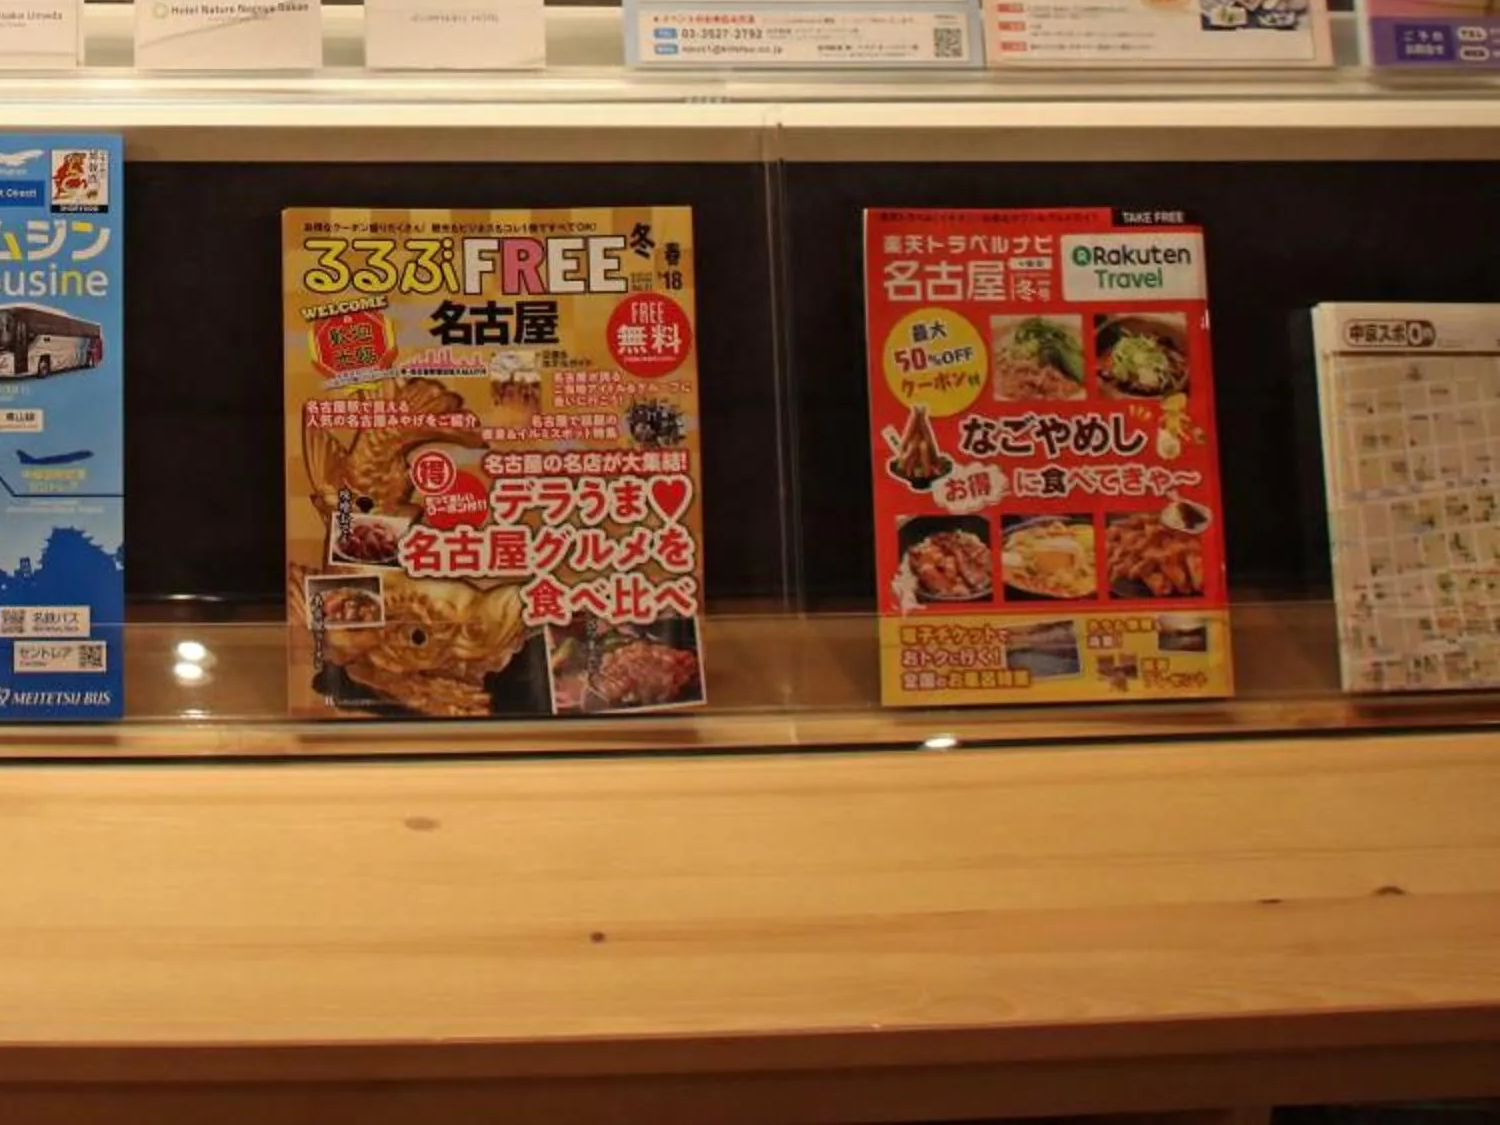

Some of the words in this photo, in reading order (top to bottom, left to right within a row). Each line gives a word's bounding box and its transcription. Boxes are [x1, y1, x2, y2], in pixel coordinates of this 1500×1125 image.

[1122, 211, 1152, 224] TAKE
[1154, 211, 1185, 224] FREE
[629, 221, 656, 260] 冬
[883, 234, 1054, 255] 楽天トラベルナビ
[303, 235, 629, 295] るるぶFREE
[1093, 245, 1192, 265] Rakuten
[883, 260, 1006, 302] 名古屋
[1094, 269, 1164, 290] Travel
[301, 296, 389, 320] WELCOME
[631, 301, 665, 324] FREE
[429, 300, 560, 346] 名古屋
[911, 321, 948, 343] 最大
[617, 323, 682, 355] 無料
[894, 346, 974, 373] 50%OFF
[961, 414, 1147, 457] なごやめし
[484, 451, 689, 475] 名古屋の名店が大集結!
[494, 477, 646, 523] デラうま
[403, 527, 695, 574] 名古屋グルメを
[525, 577, 696, 623] 食べ比べ
[19, 645, 73, 660] セントレア
[11, 690, 82, 706] MEITETSU
[84, 690, 112, 706] BUS
